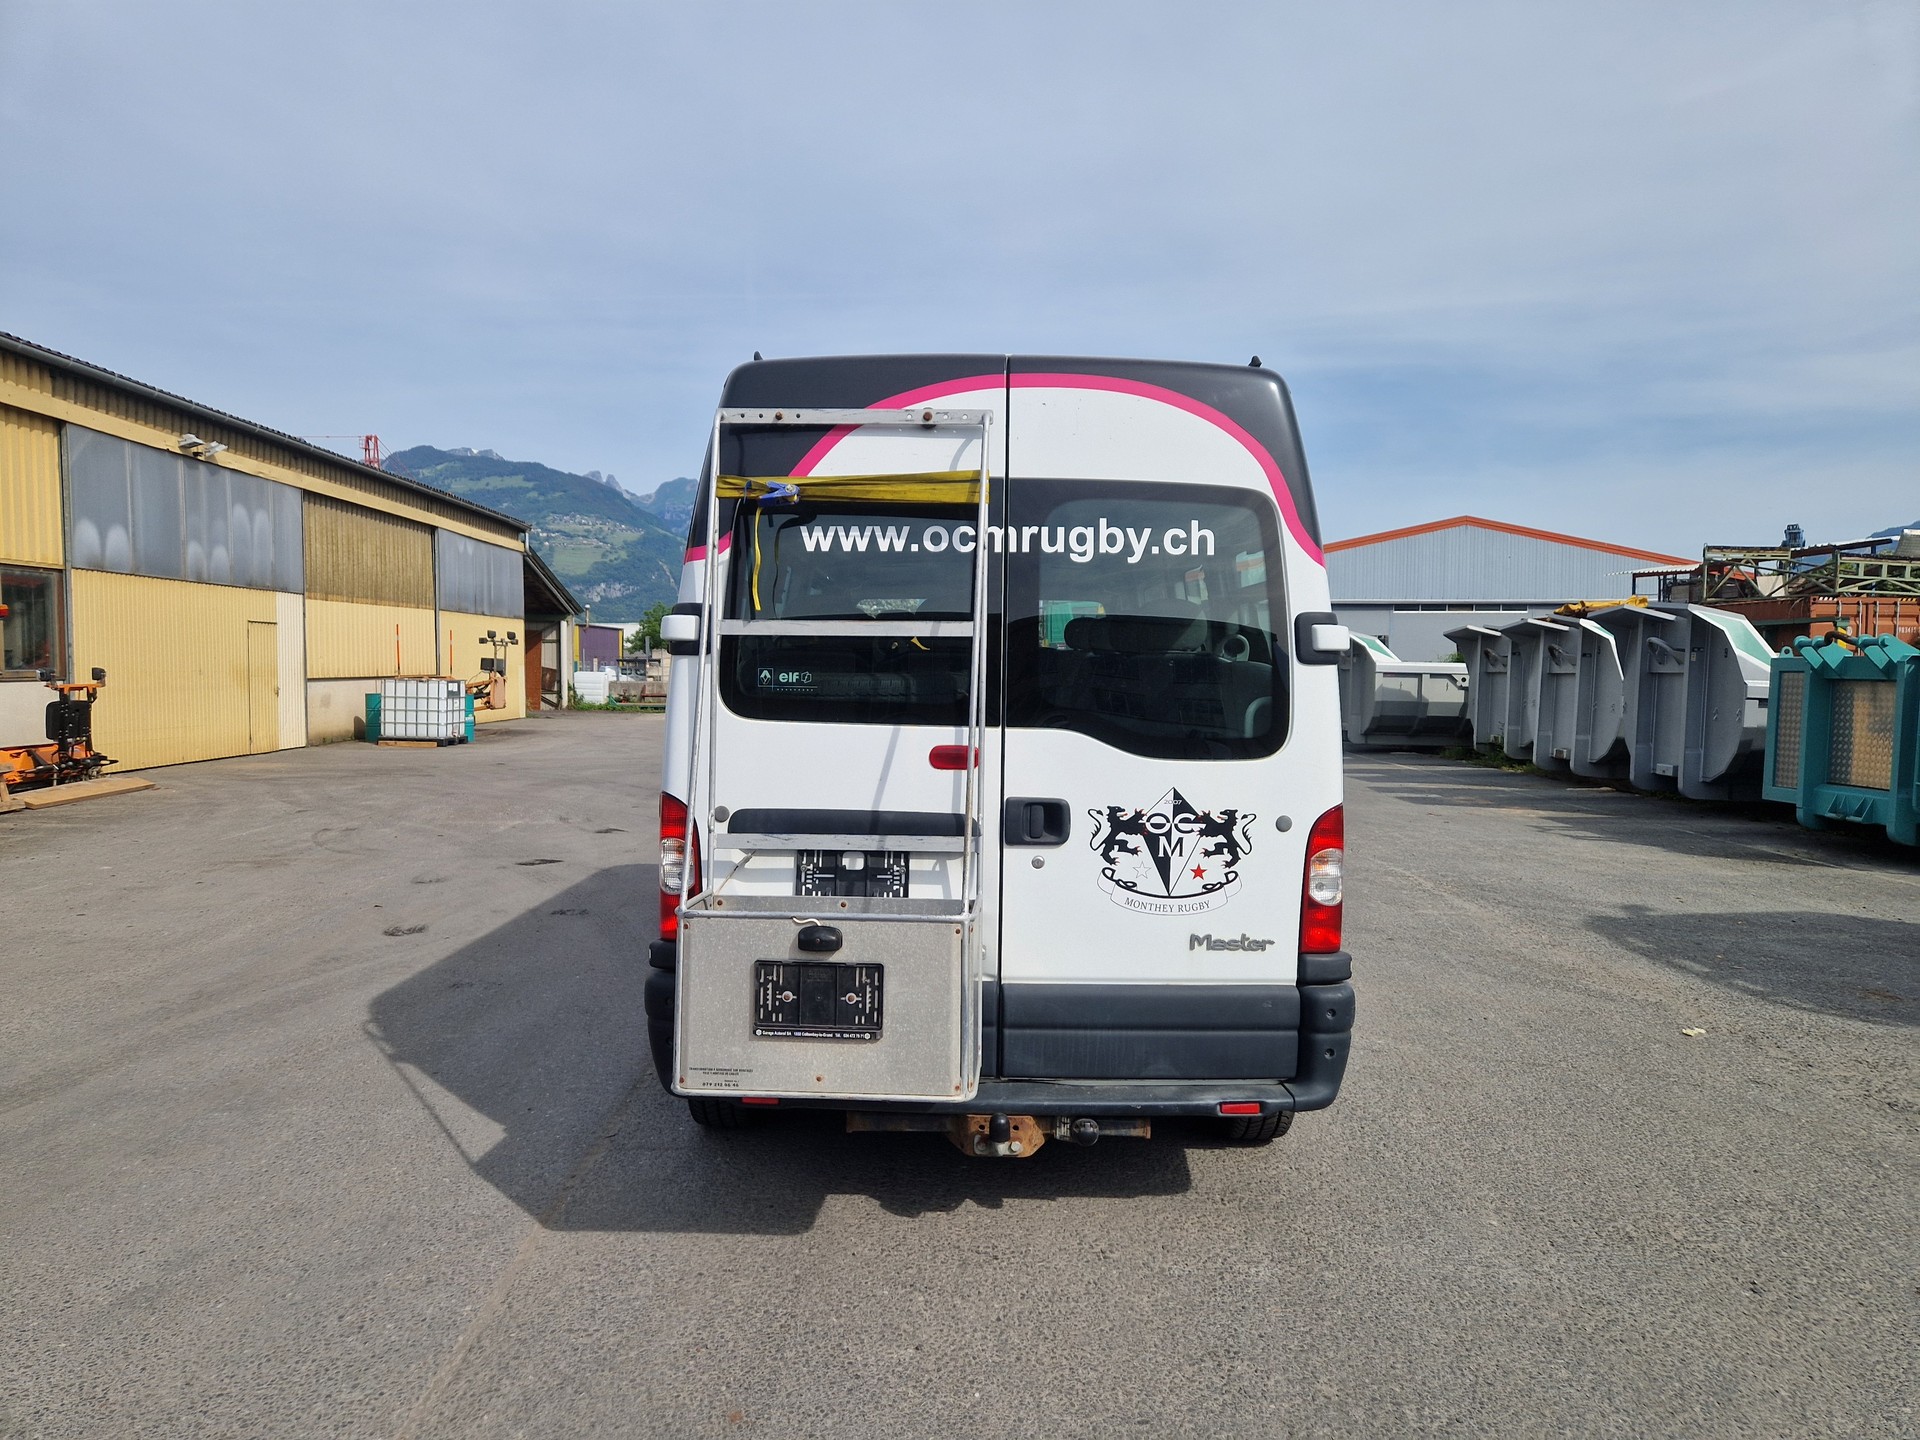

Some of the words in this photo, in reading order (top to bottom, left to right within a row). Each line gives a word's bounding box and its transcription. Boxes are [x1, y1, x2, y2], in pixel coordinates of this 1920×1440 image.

[800, 517, 1216, 564] www.ocmrugby.ch
[778, 671, 800, 683] elf
[1124, 897, 1176, 913] MONTHEY
[1177, 900, 1211, 913] RUGBY
[1189, 933, 1275, 952] Master
